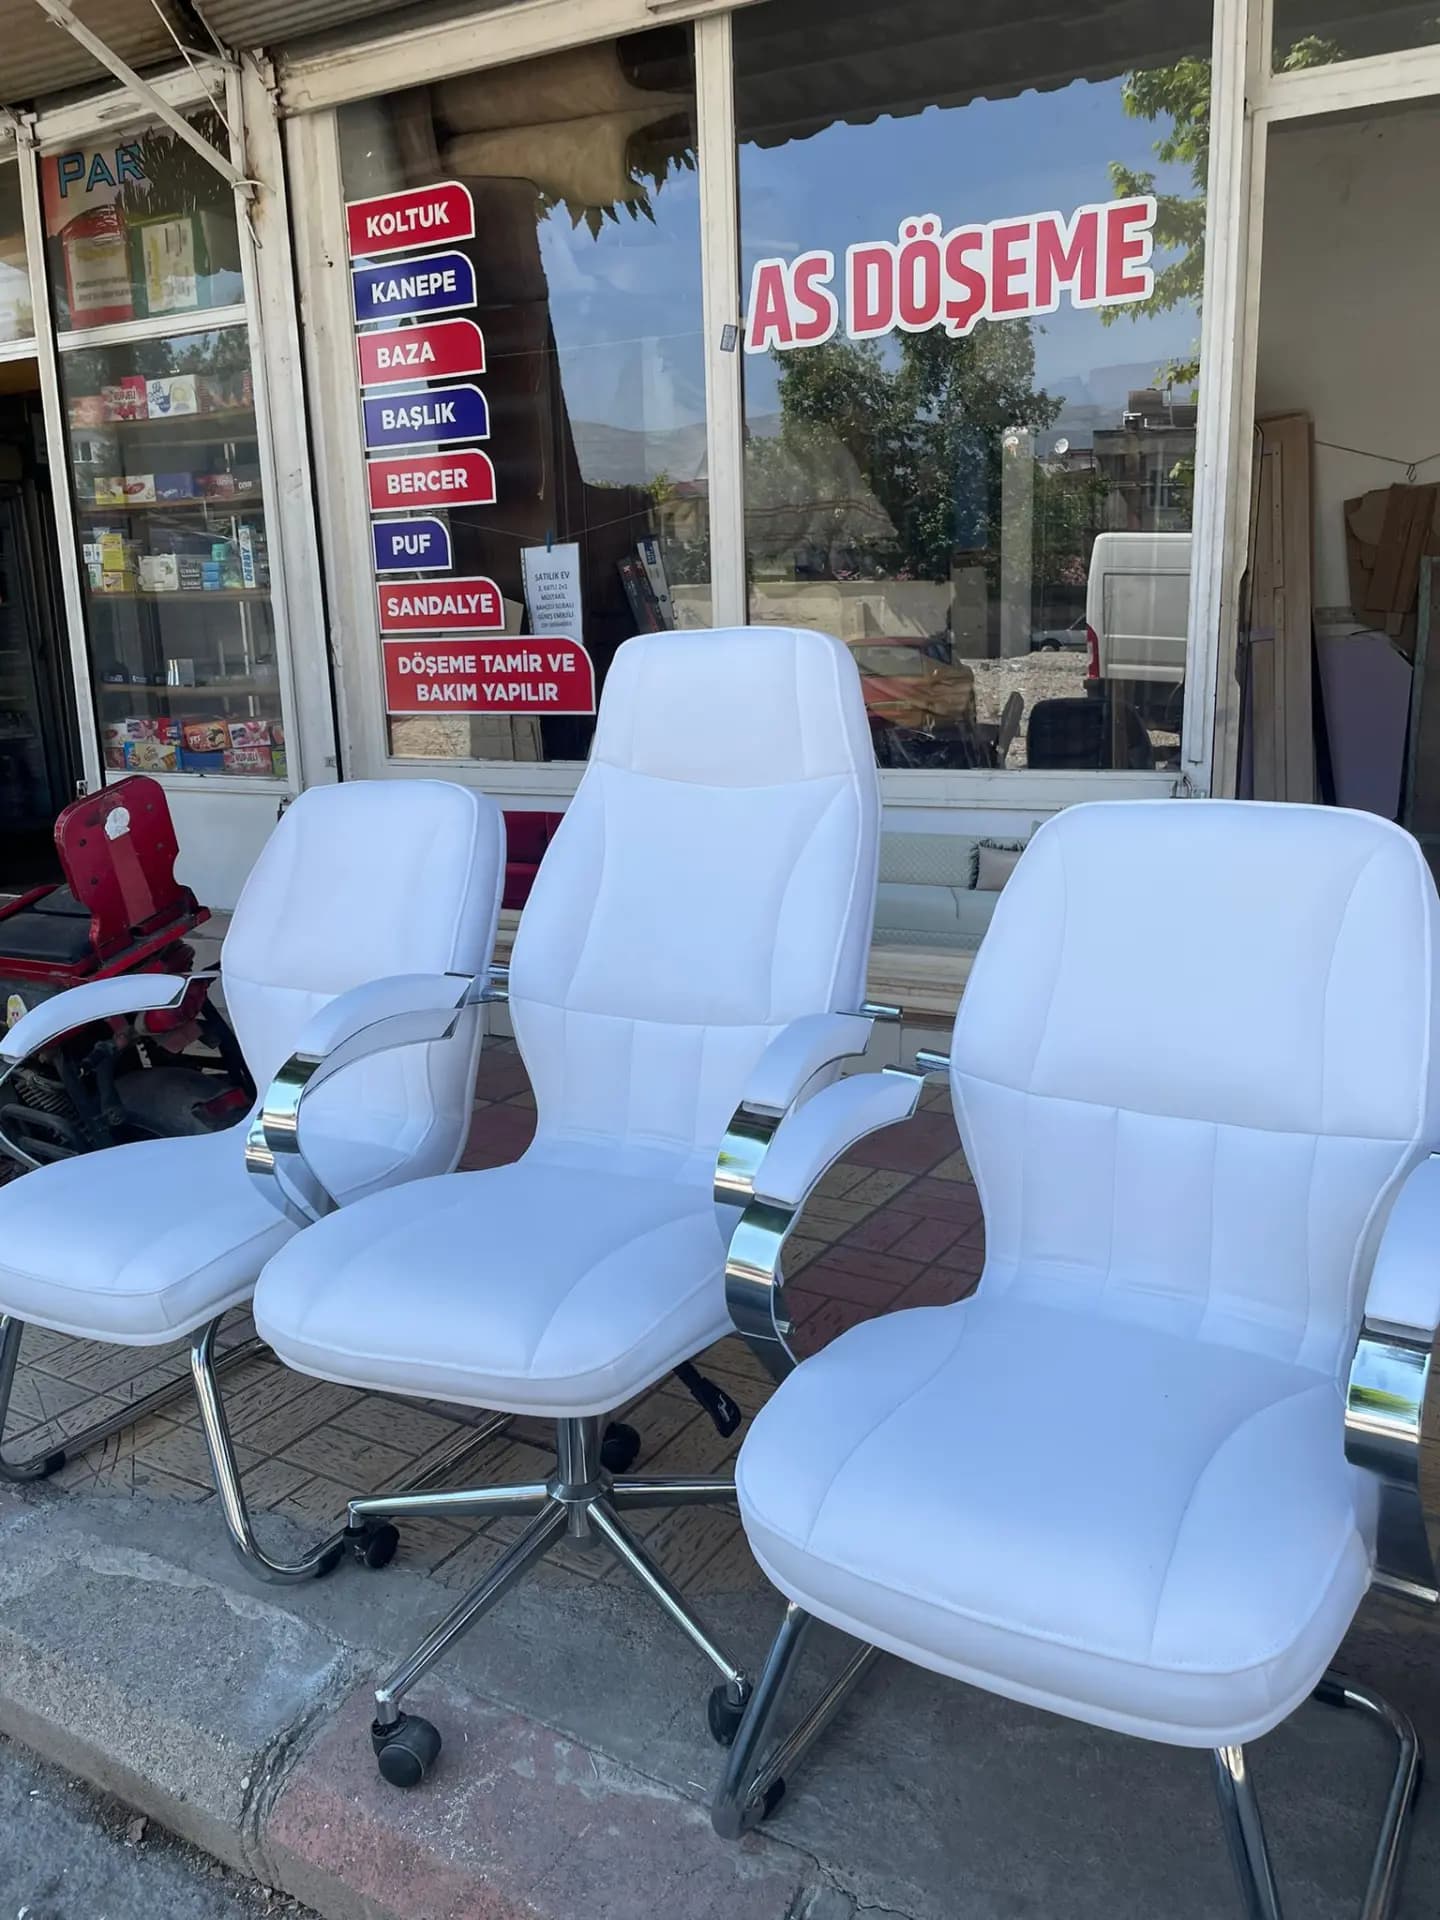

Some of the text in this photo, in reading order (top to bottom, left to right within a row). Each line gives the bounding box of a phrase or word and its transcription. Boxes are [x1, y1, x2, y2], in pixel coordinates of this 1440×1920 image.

[366, 201, 450, 238] KOLTUK
[371, 269, 457, 304] KANEPE
[750, 203, 1148, 347] AS DÖŞEME
[377, 342, 436, 368] BAZA
[381, 401, 456, 432] BAŞLIK
[386, 468, 468, 495] BERCER
[391, 534, 431, 556] PUF
[560, 571, 570, 579] EV
[386, 593, 494, 617] SANDALYE
[398, 649, 575, 676] DÖŞEME TAMİR VE
[416, 681, 558, 702] BAKIM YAPILIR
